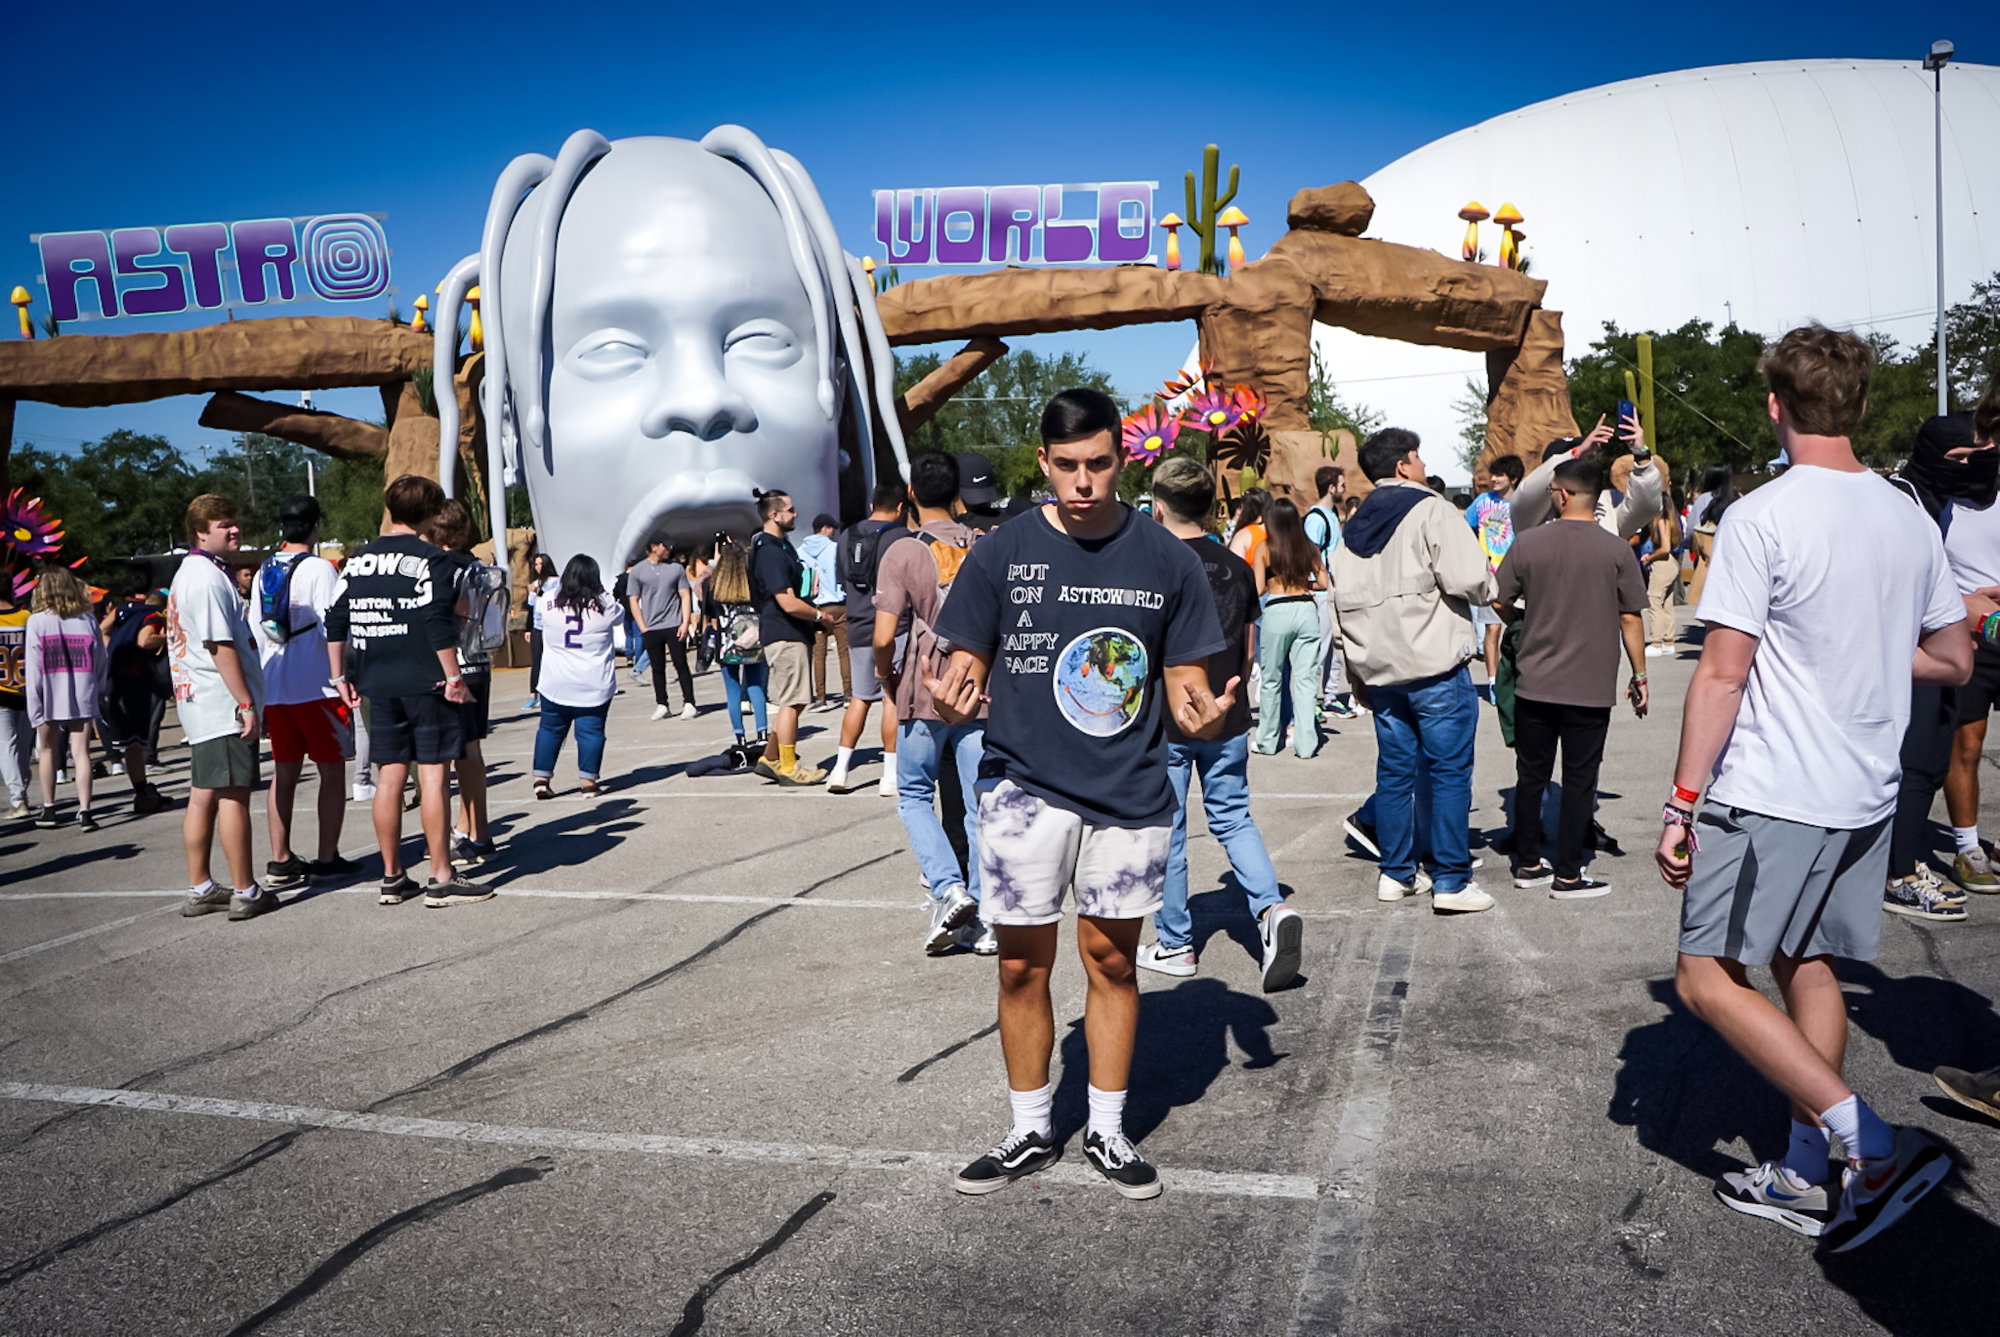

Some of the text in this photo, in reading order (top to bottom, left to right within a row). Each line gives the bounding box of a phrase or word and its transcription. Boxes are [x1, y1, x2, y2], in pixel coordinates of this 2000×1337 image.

[875, 181, 1153, 265] WORLD
[39, 213, 391, 323] ASTRO
[1007, 563, 1050, 581] PUT
[1010, 586, 1044, 604] ON
[1057, 585, 1165, 610] ASTROWORLD
[1017, 610, 1033, 627] A
[564, 615, 584, 649] 2
